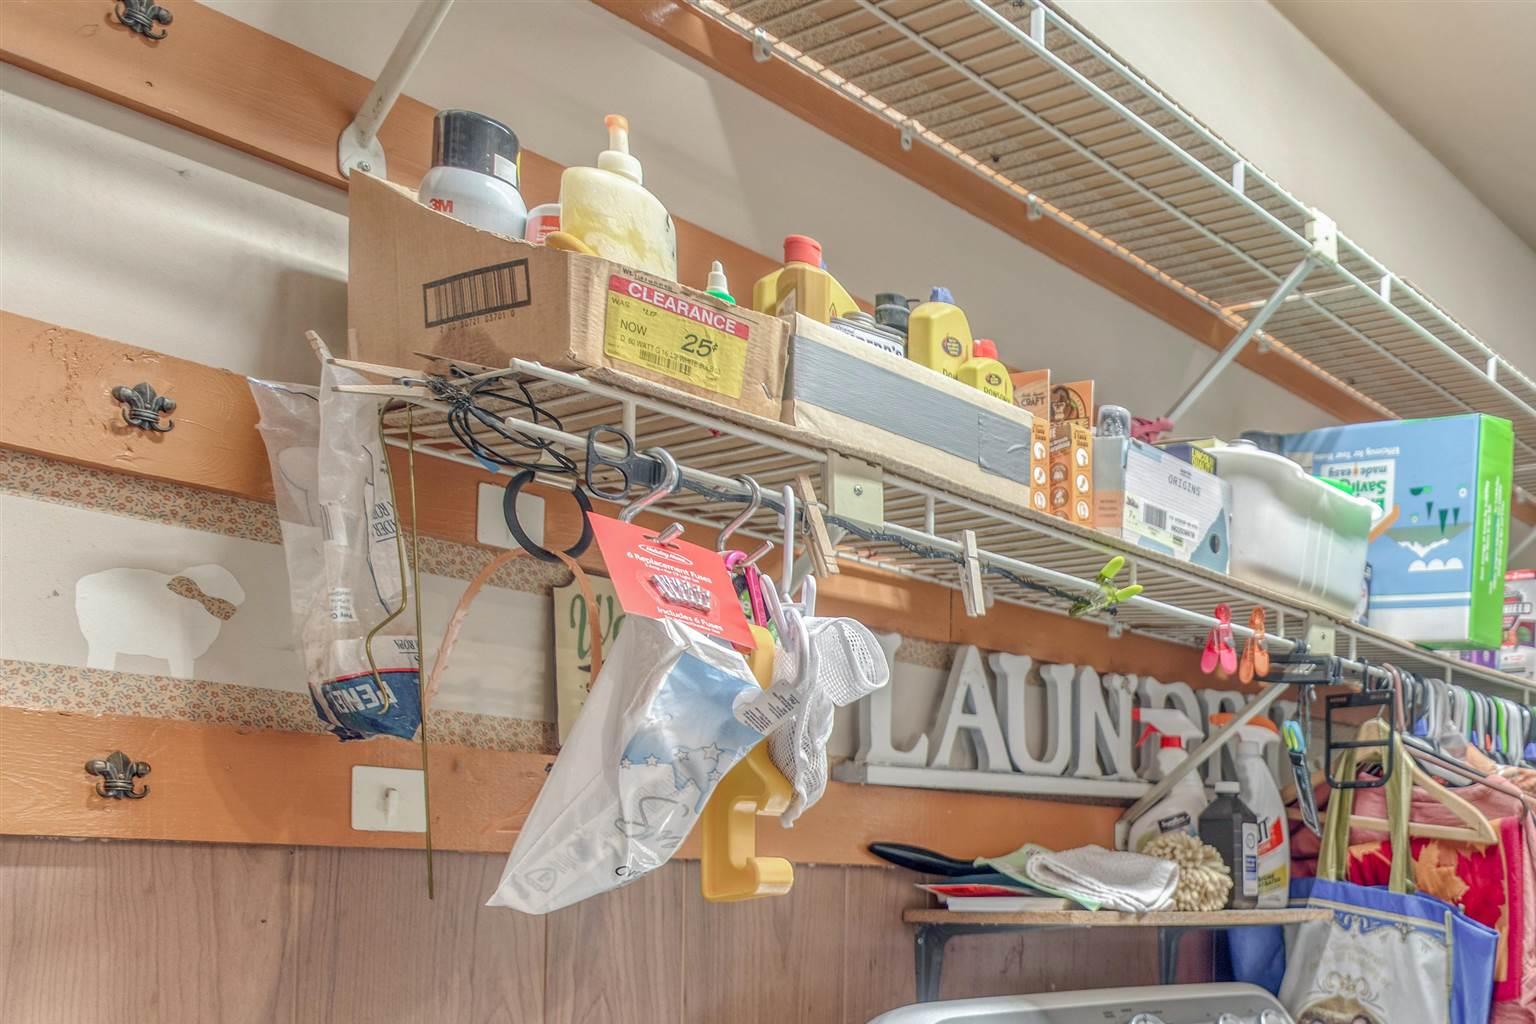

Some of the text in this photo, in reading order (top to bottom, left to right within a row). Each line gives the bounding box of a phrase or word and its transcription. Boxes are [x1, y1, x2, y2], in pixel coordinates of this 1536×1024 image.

[429, 198, 453, 213] 3M
[627, 282, 736, 334] CLEARANCE
[620, 319, 648, 336] NOW
[1020, 396, 1046, 407] CRAFT
[1328, 464, 1388, 478] made easy
[1167, 473, 1201, 497] ORIGINS
[626, 551, 634, 559] 6
[634, 552, 689, 577] Replacement
[690, 569, 713, 585] Fuses
[656, 605, 693, 622] Includes
[694, 615, 702, 624] 6
[702, 618, 724, 632] Fuses
